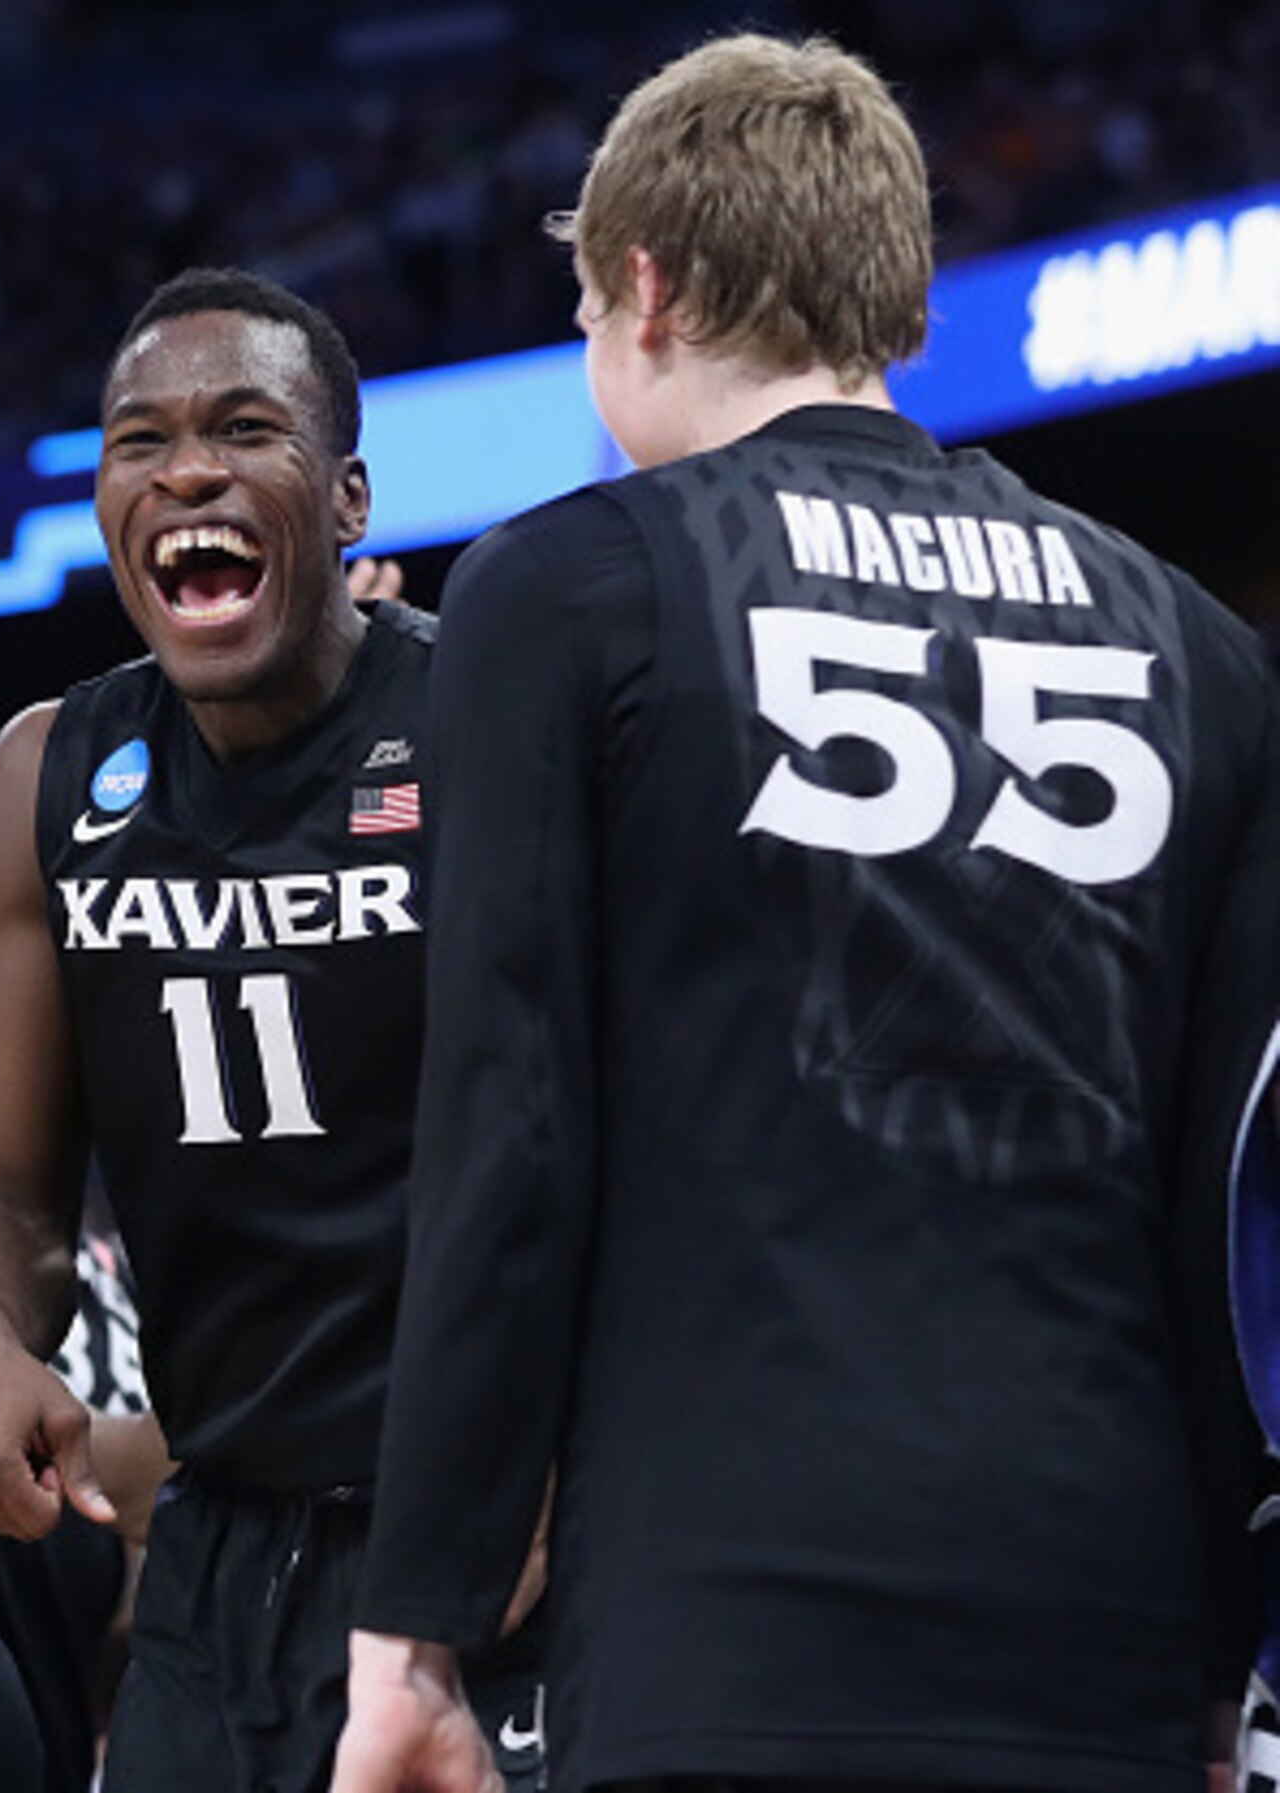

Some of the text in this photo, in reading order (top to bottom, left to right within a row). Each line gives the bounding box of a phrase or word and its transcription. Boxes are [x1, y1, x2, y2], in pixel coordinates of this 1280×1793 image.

[775, 491, 1095, 606] MACURA
[737, 607, 1173, 886] 55
[56, 864, 421, 949] XAVIER
[159, 973, 328, 1144] 11
